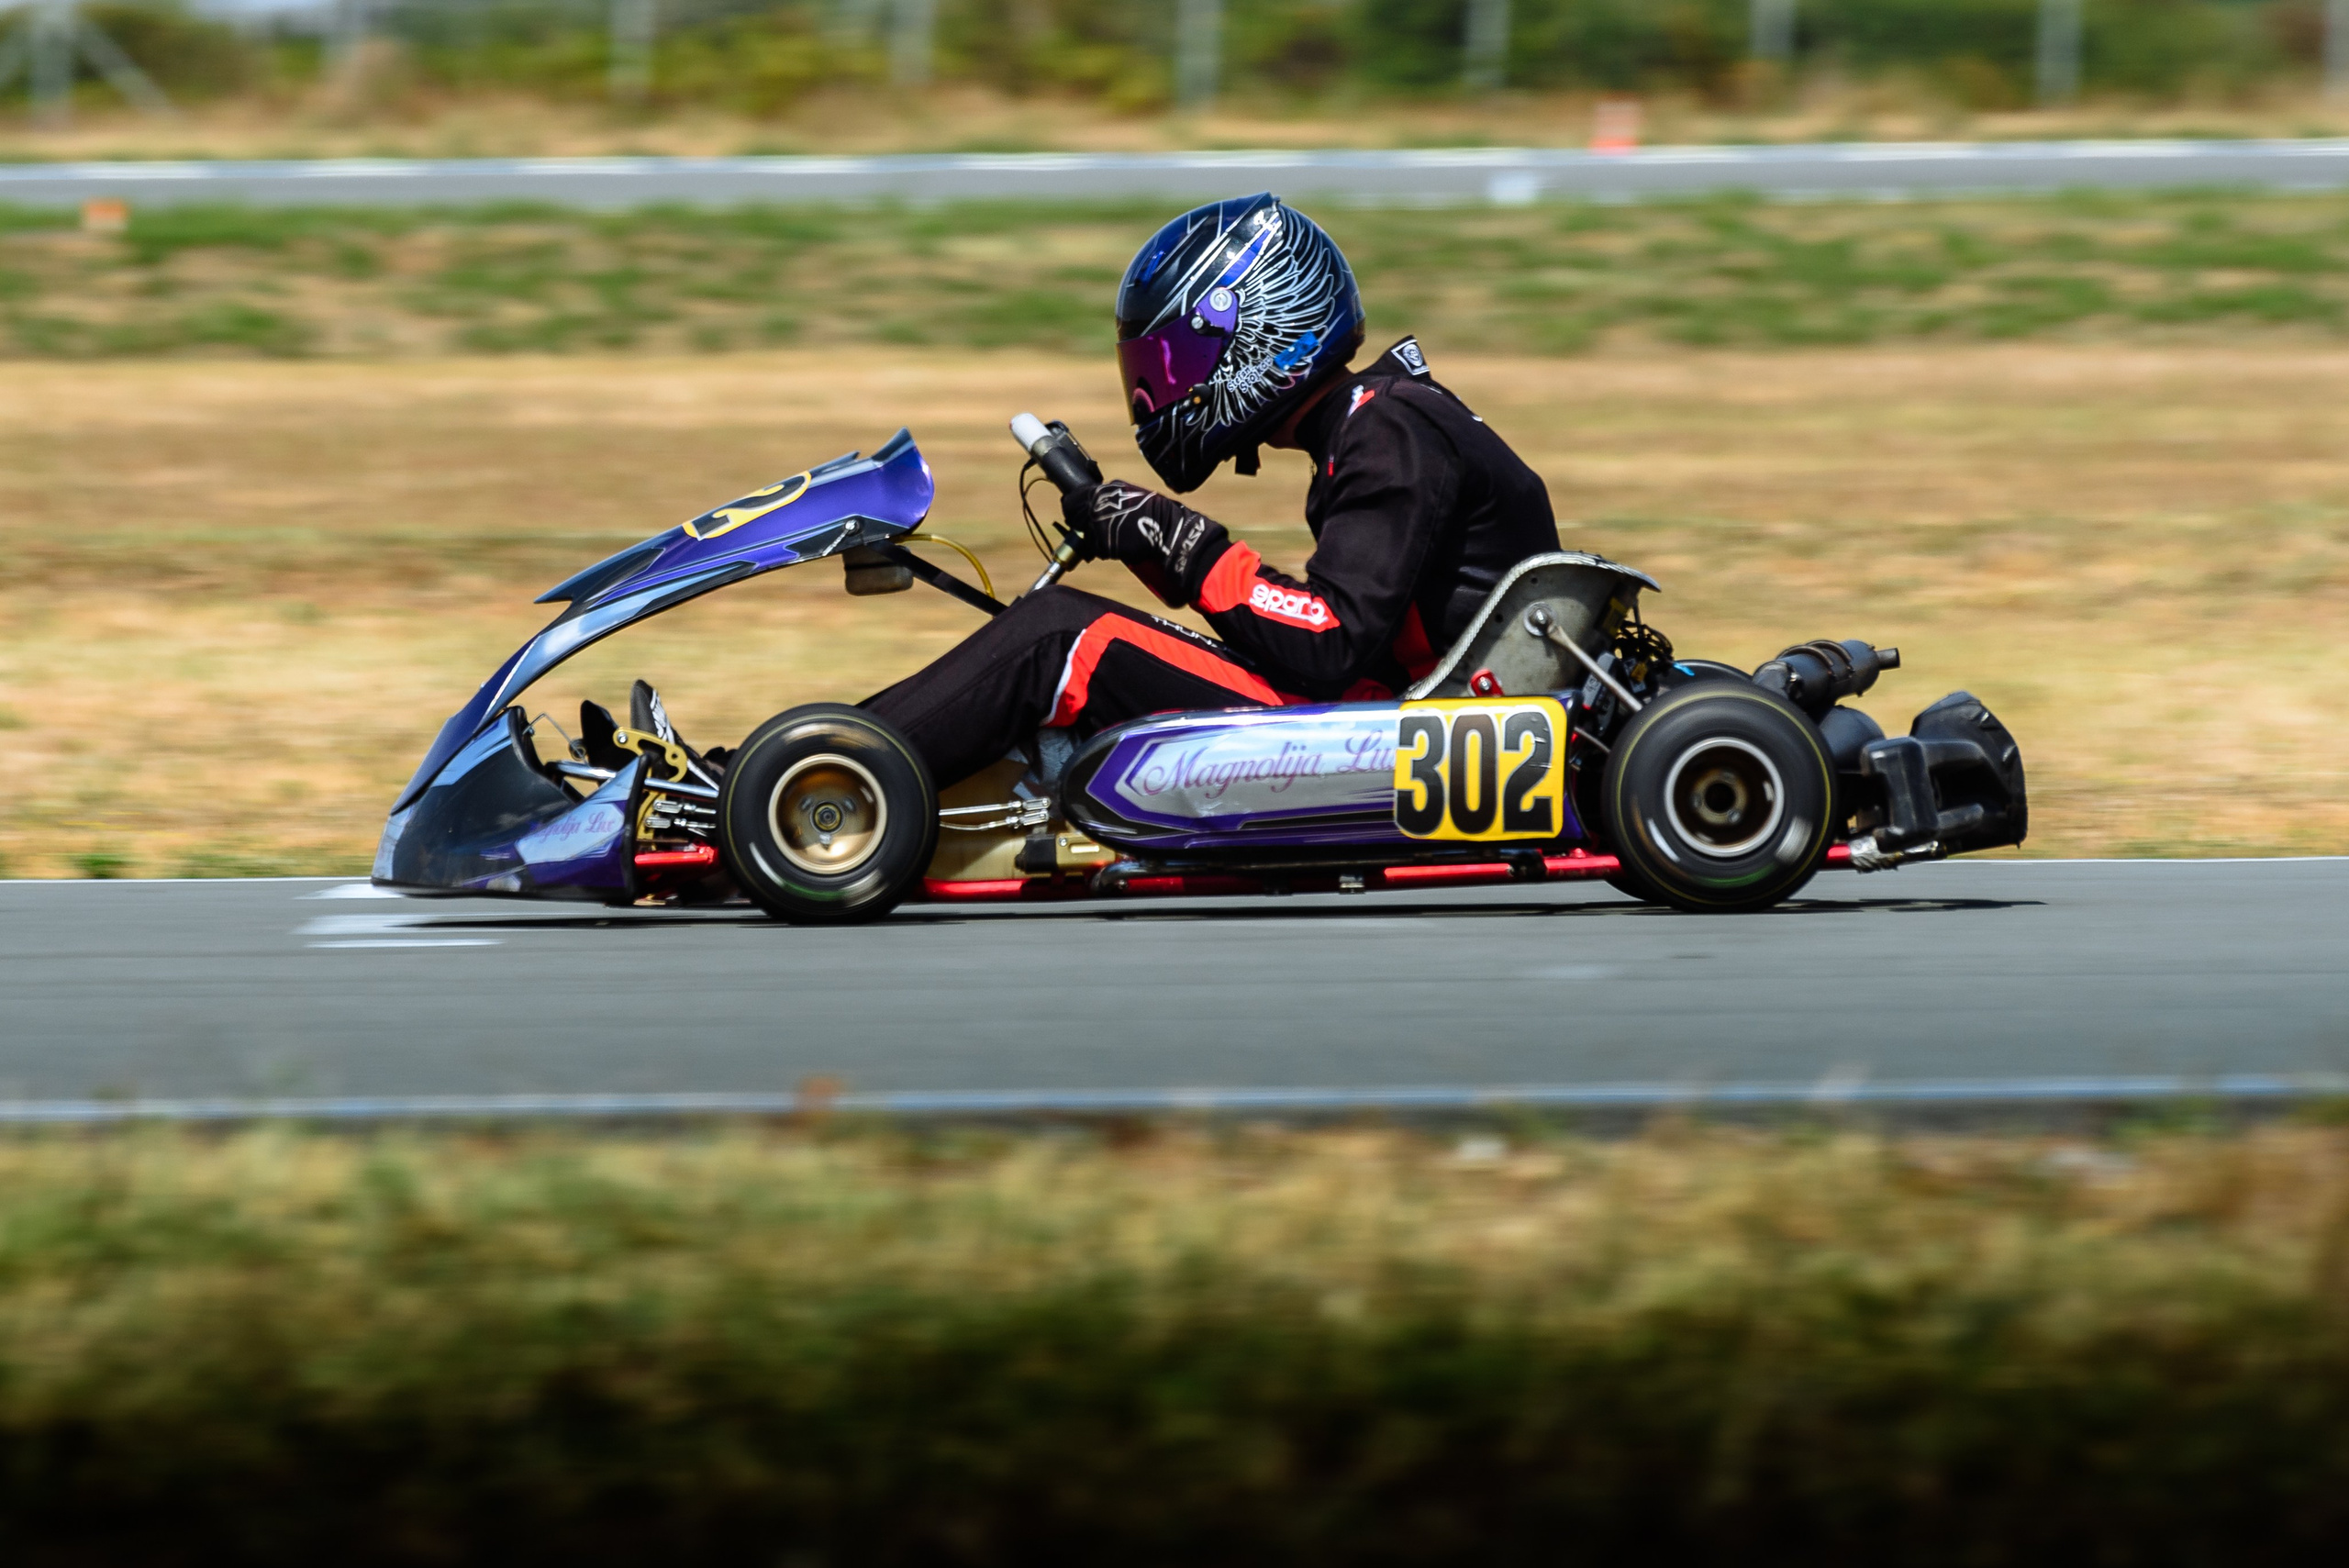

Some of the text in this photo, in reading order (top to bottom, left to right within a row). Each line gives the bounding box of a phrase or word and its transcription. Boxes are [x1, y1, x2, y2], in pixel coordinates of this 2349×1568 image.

[1143, 728, 1395, 799] Magnolija Lu
[1395, 706, 1553, 836] 302
